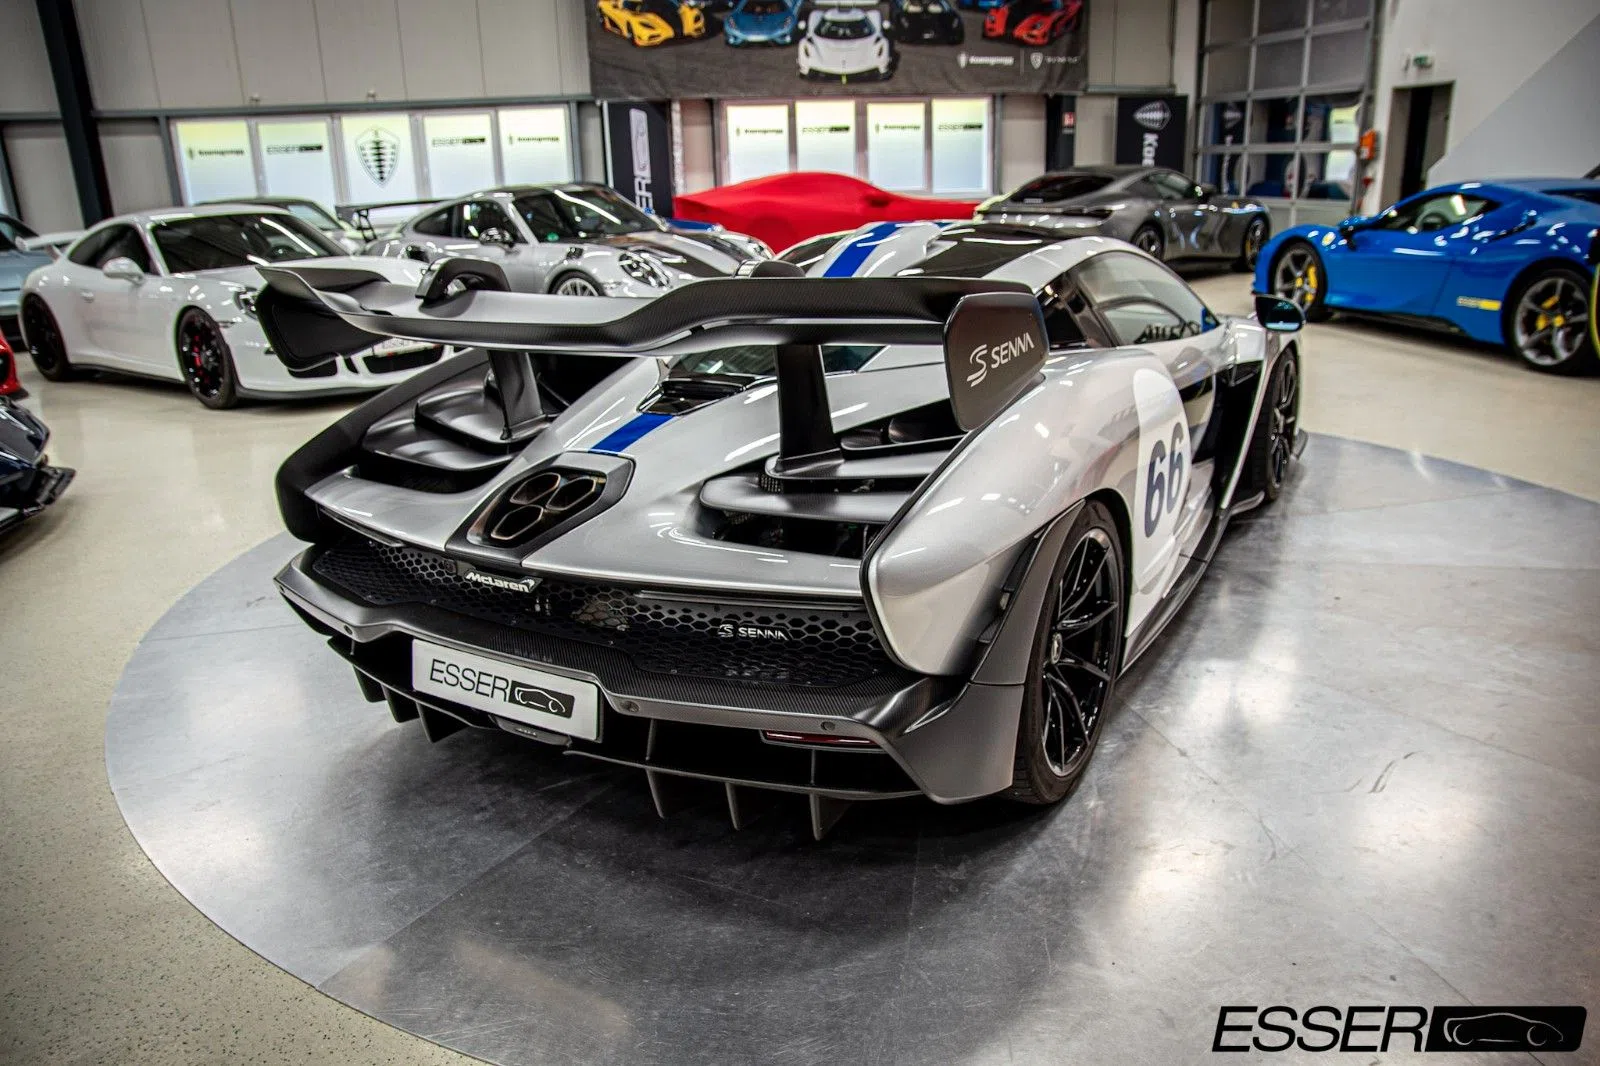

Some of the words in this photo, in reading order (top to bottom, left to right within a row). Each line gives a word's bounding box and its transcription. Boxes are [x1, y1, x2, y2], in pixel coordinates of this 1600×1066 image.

[990, 332, 1034, 369] SENNA
[1144, 421, 1185, 538] 66
[465, 571, 530, 593] McLaren
[738, 627, 789, 641] SENNA
[429, 658, 510, 703] ESSER
